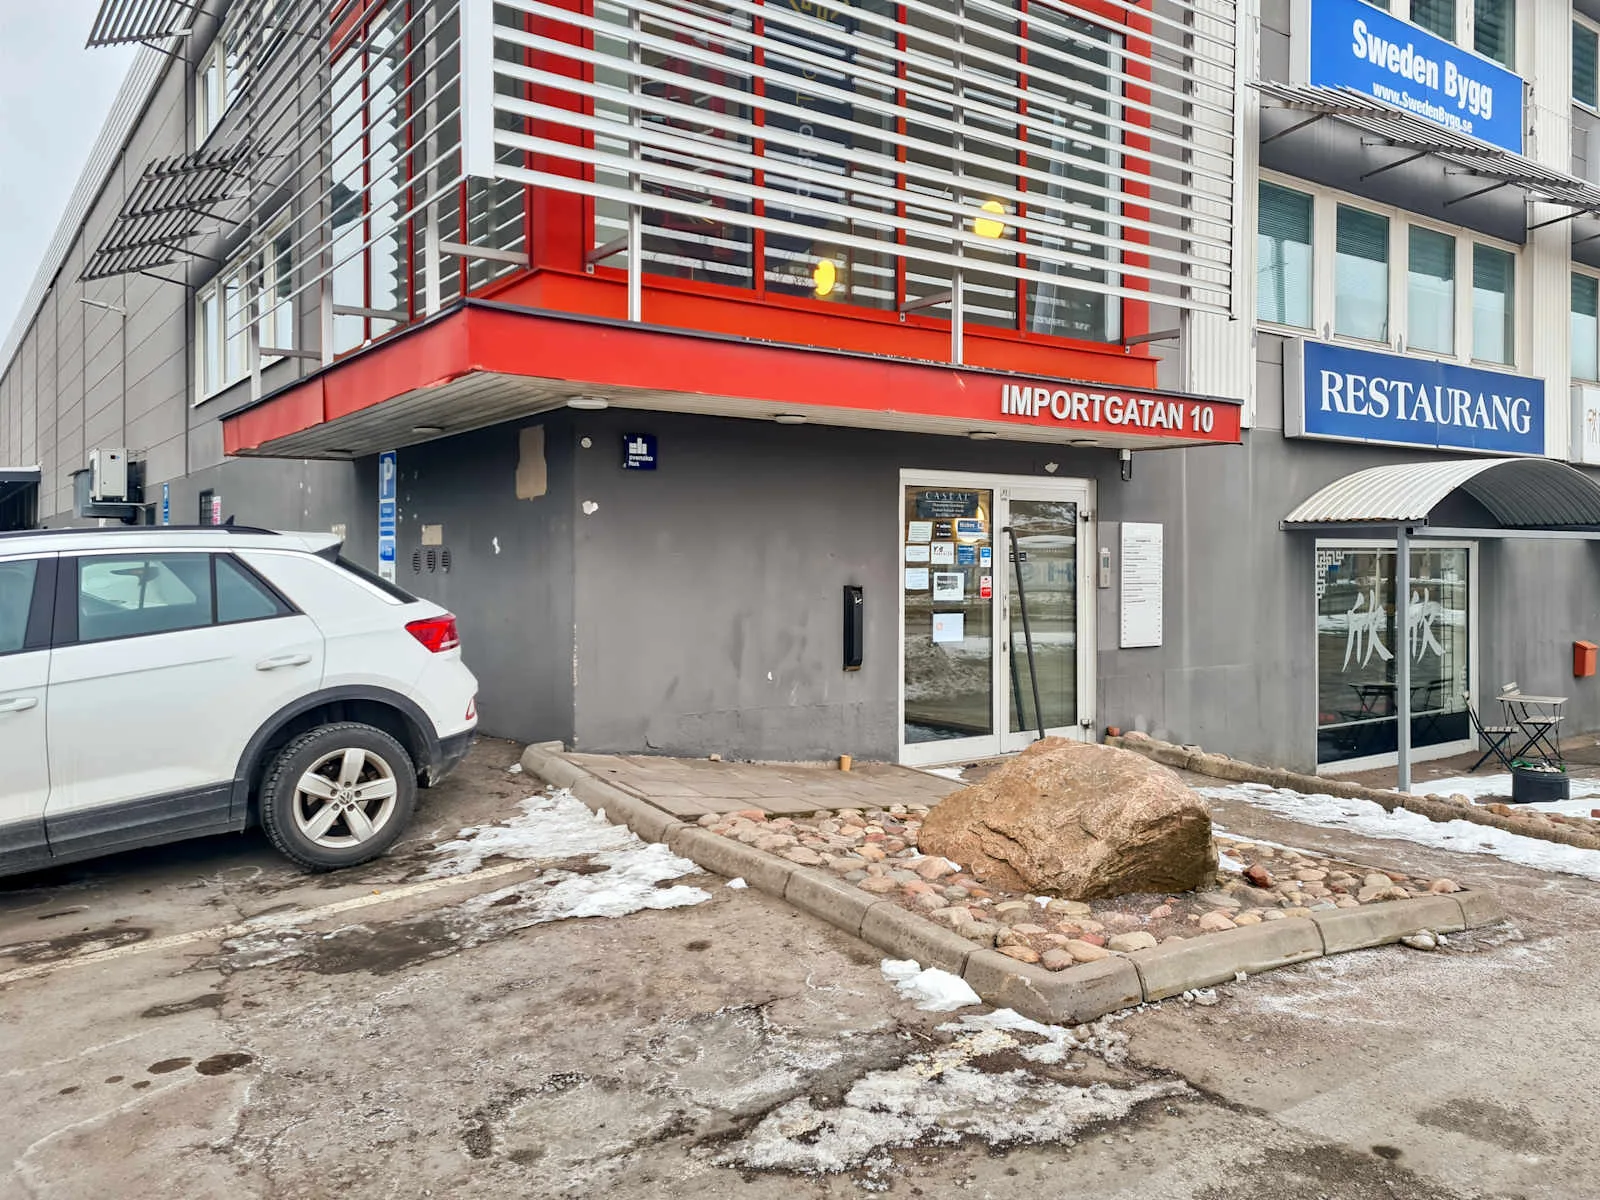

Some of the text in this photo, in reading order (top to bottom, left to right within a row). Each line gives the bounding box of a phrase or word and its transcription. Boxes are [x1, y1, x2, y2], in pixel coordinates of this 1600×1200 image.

[1352, 19, 1493, 121] Sweden Bygg
[1373, 83, 1473, 133] www.SwedenBygg.se
[1001, 384, 1214, 433] IMPORTGATAN 10
[1320, 369, 1532, 434] RESTAURANG
[383, 456, 394, 496] P
